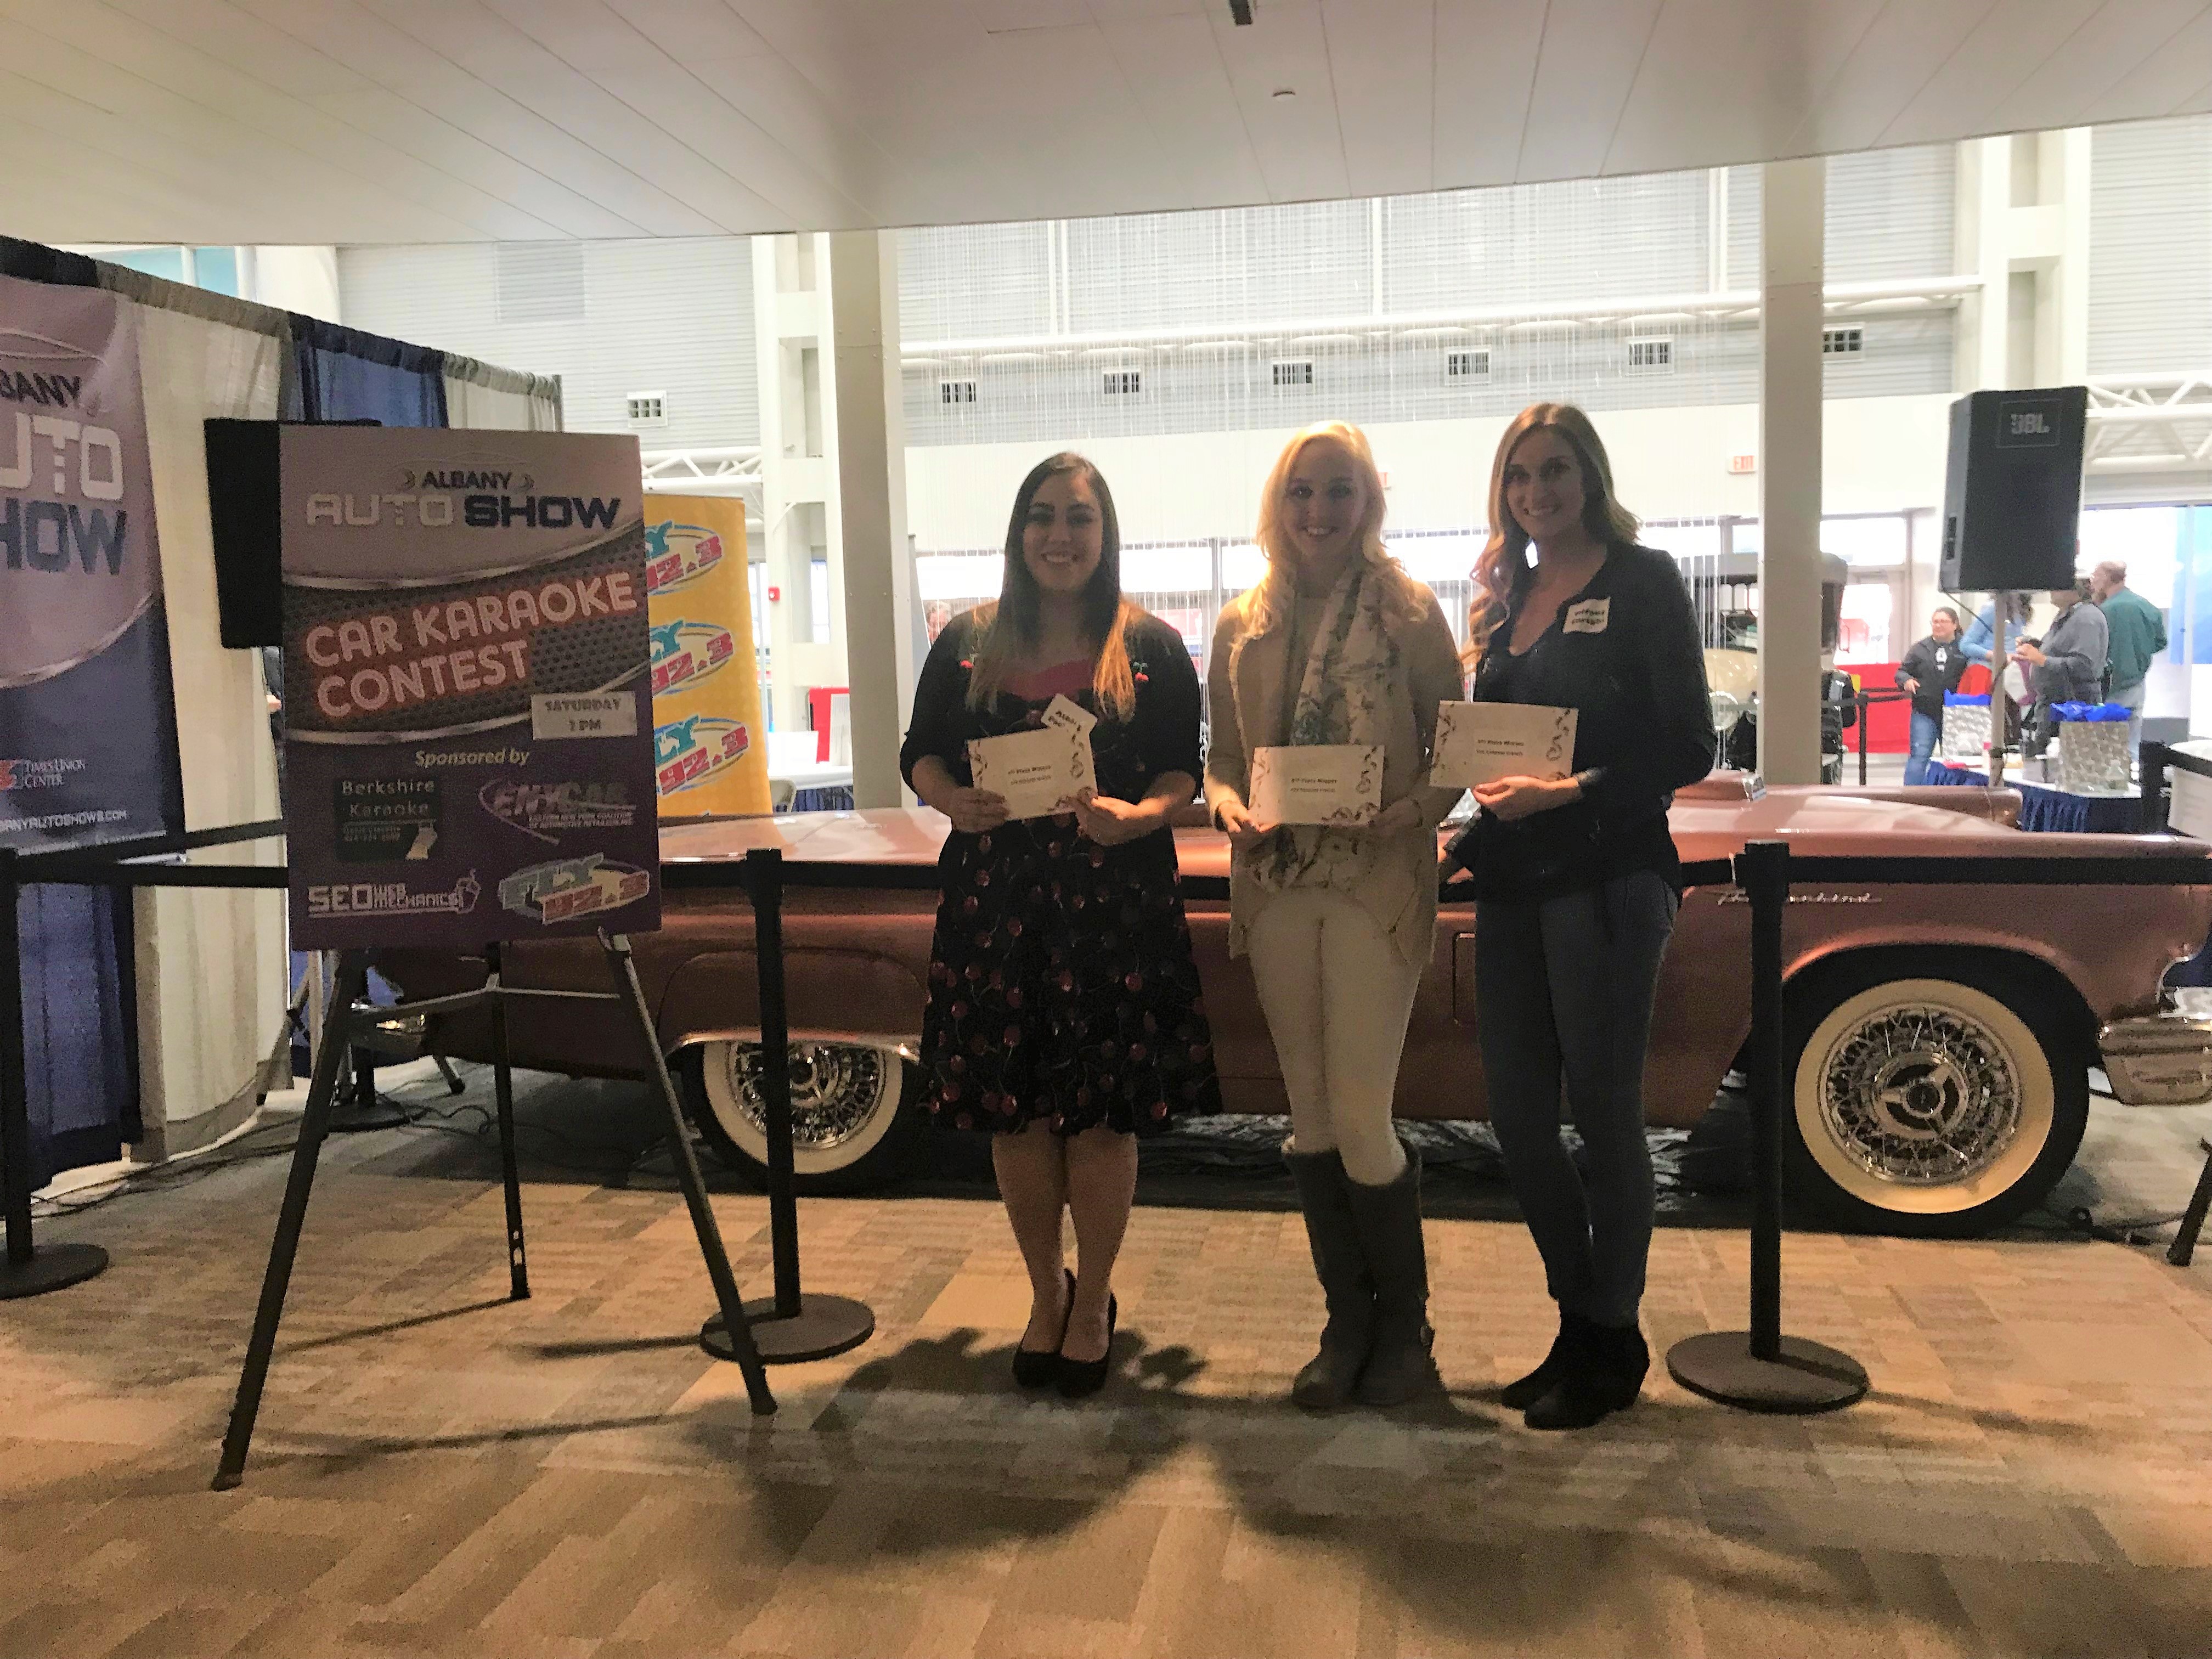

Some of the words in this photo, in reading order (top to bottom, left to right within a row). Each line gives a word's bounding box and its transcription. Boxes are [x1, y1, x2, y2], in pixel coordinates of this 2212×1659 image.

[2011, 414, 2050, 435] JBL
[421, 471, 513, 490] ALBANY
[307, 493, 454, 527] AUTO
[464, 495, 621, 528] SHOW
[306, 614, 403, 668] CAR
[412, 572, 637, 648] KARAOKE
[317, 639, 528, 717] CONTEST
[545, 698, 622, 712] SATURDAY
[578, 719, 601, 731] PM
[653, 715, 697, 767] LY
[415, 749, 504, 768] Sponsored
[507, 748, 531, 765] by
[659, 726, 748, 795] 92.3
[342, 778, 435, 795] Berkshire
[349, 800, 429, 817] Karaoke
[308, 883, 374, 912] SEO
